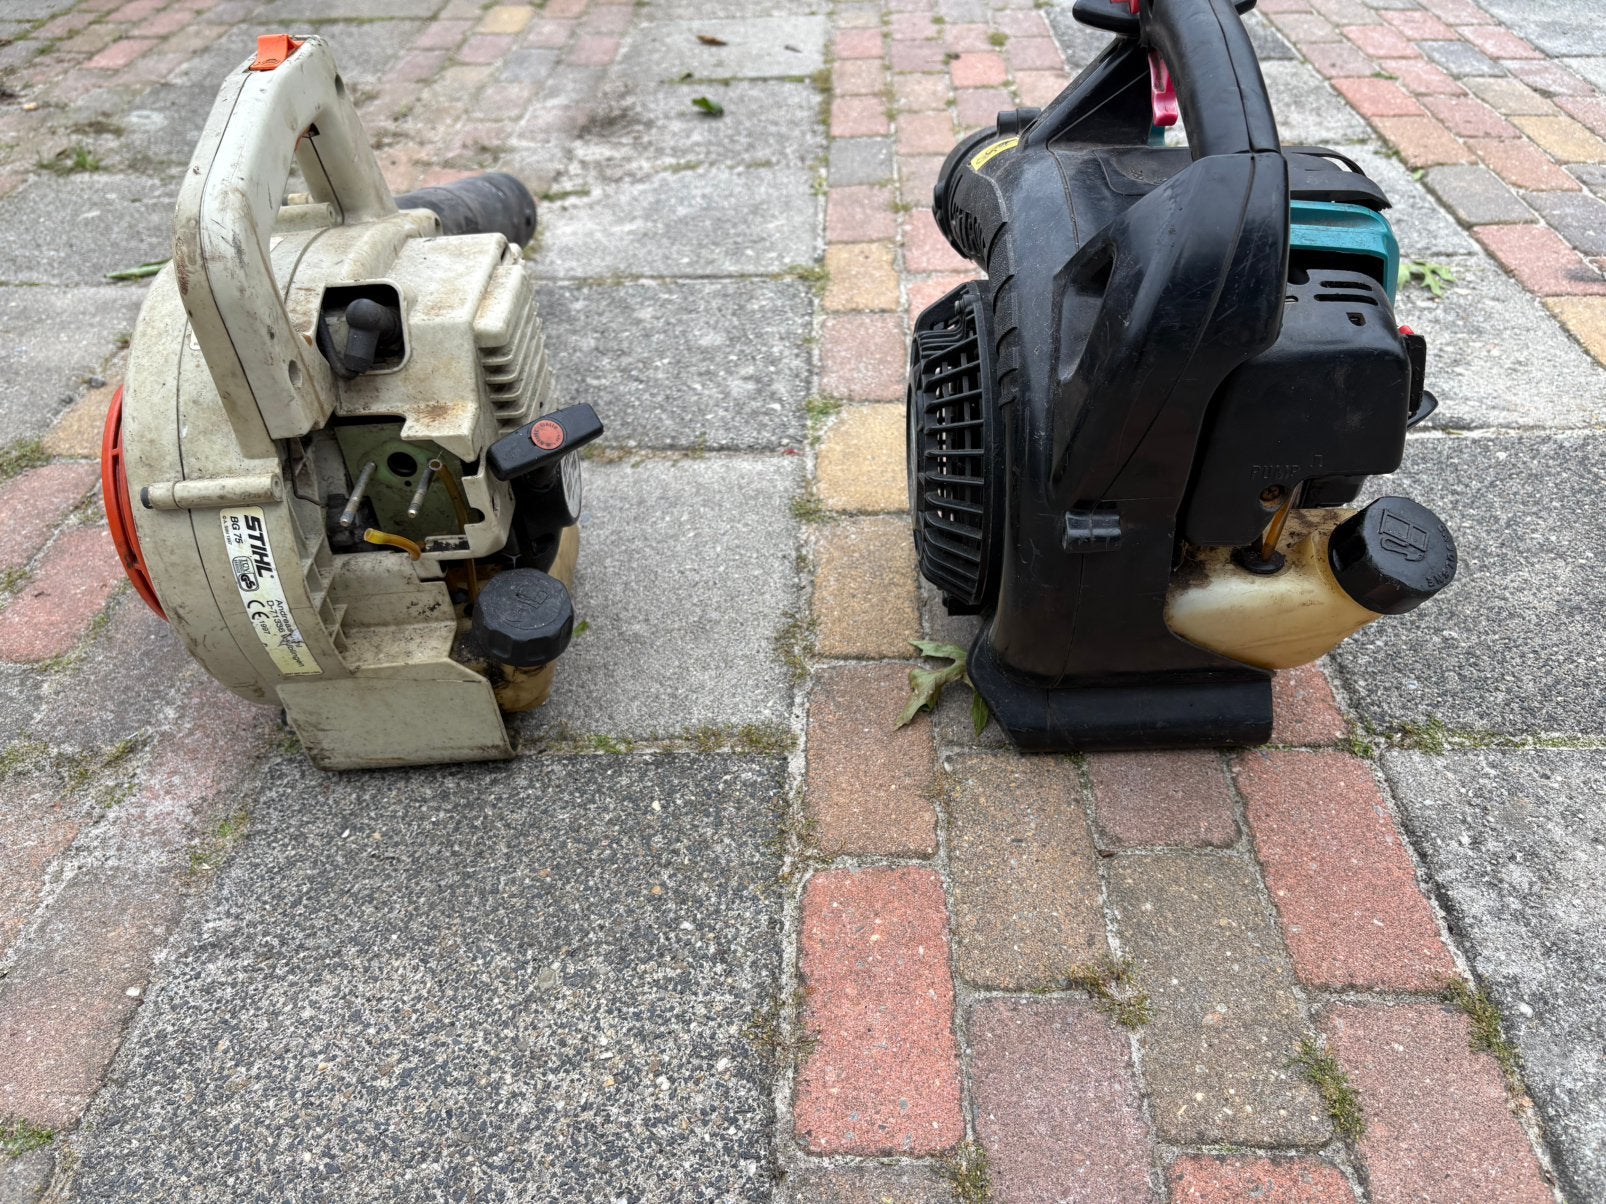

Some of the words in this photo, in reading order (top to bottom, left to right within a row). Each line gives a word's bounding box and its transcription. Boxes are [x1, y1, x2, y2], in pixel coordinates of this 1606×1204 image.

[230, 515, 241, 531] BG
[233, 532, 244, 544] 75
[244, 514, 273, 578] STIHL
[259, 620, 271, 635] 1997
